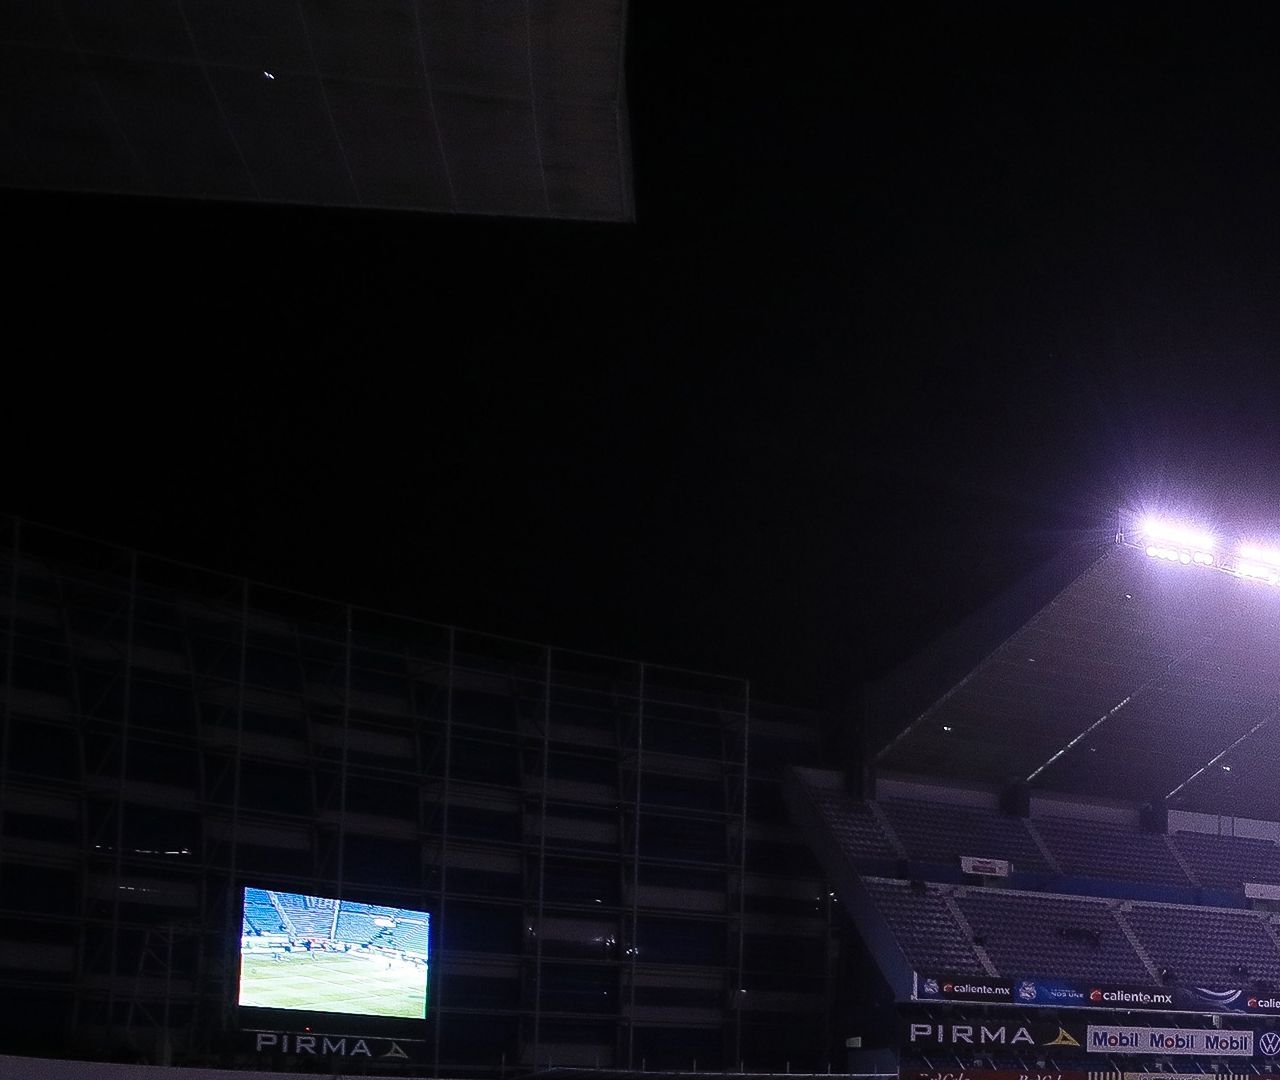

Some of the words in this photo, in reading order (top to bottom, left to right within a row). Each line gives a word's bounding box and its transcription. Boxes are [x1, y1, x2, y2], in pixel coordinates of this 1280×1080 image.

[954, 984, 1010, 994] caliente.mx
[1103, 989, 1172, 1005] caliente.mx
[910, 1024, 1035, 1045] PIRMA
[1093, 1032, 1138, 1047] Mobil
[1150, 1032, 1194, 1049] Mobil
[1206, 1036, 1247, 1050] Mobil
[256, 1033, 372, 1057] PIRMA
